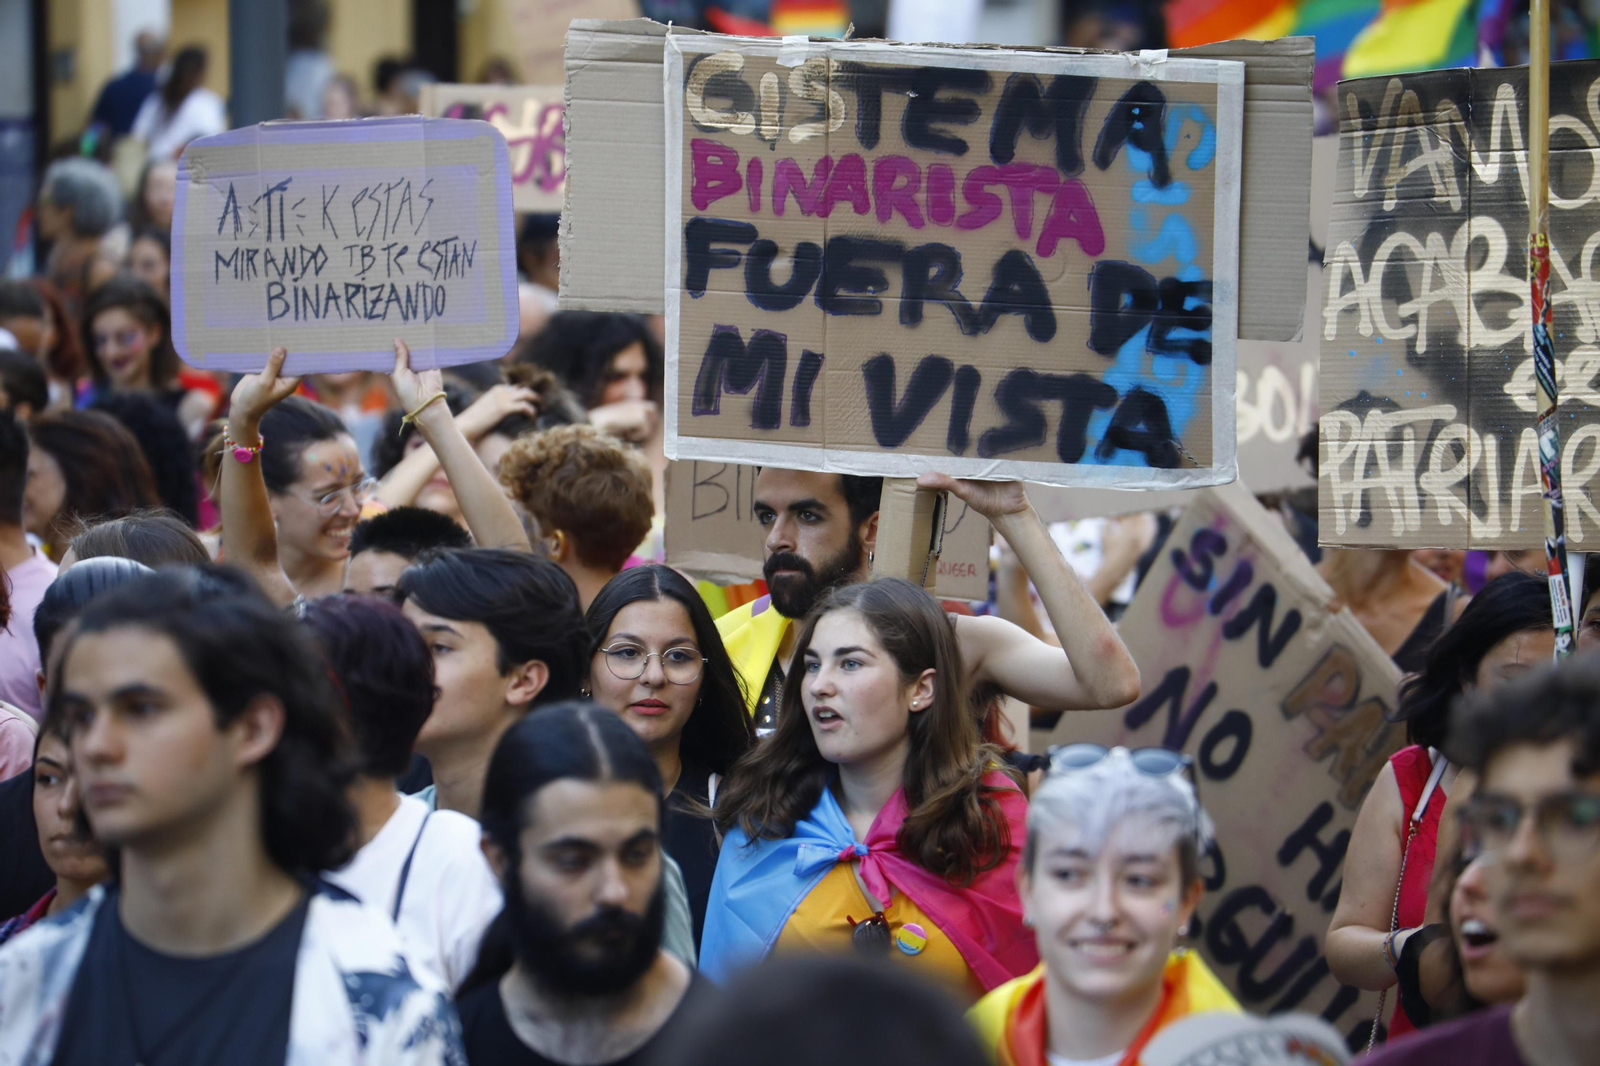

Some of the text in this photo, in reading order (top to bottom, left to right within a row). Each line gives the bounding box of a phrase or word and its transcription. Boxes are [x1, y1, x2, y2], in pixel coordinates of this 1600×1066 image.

[684, 51, 1172, 190] CISTEMA
[218, 182, 243, 241] A
[322, 185, 339, 239] K
[690, 138, 1105, 258] BINARISTA
[214, 244, 329, 284] MIRANDO
[685, 216, 1213, 366] FUERA DE
[692, 323, 1181, 469] MI VISTA
[1171, 527, 1302, 669] SIN
[1124, 665, 1253, 782] NO
